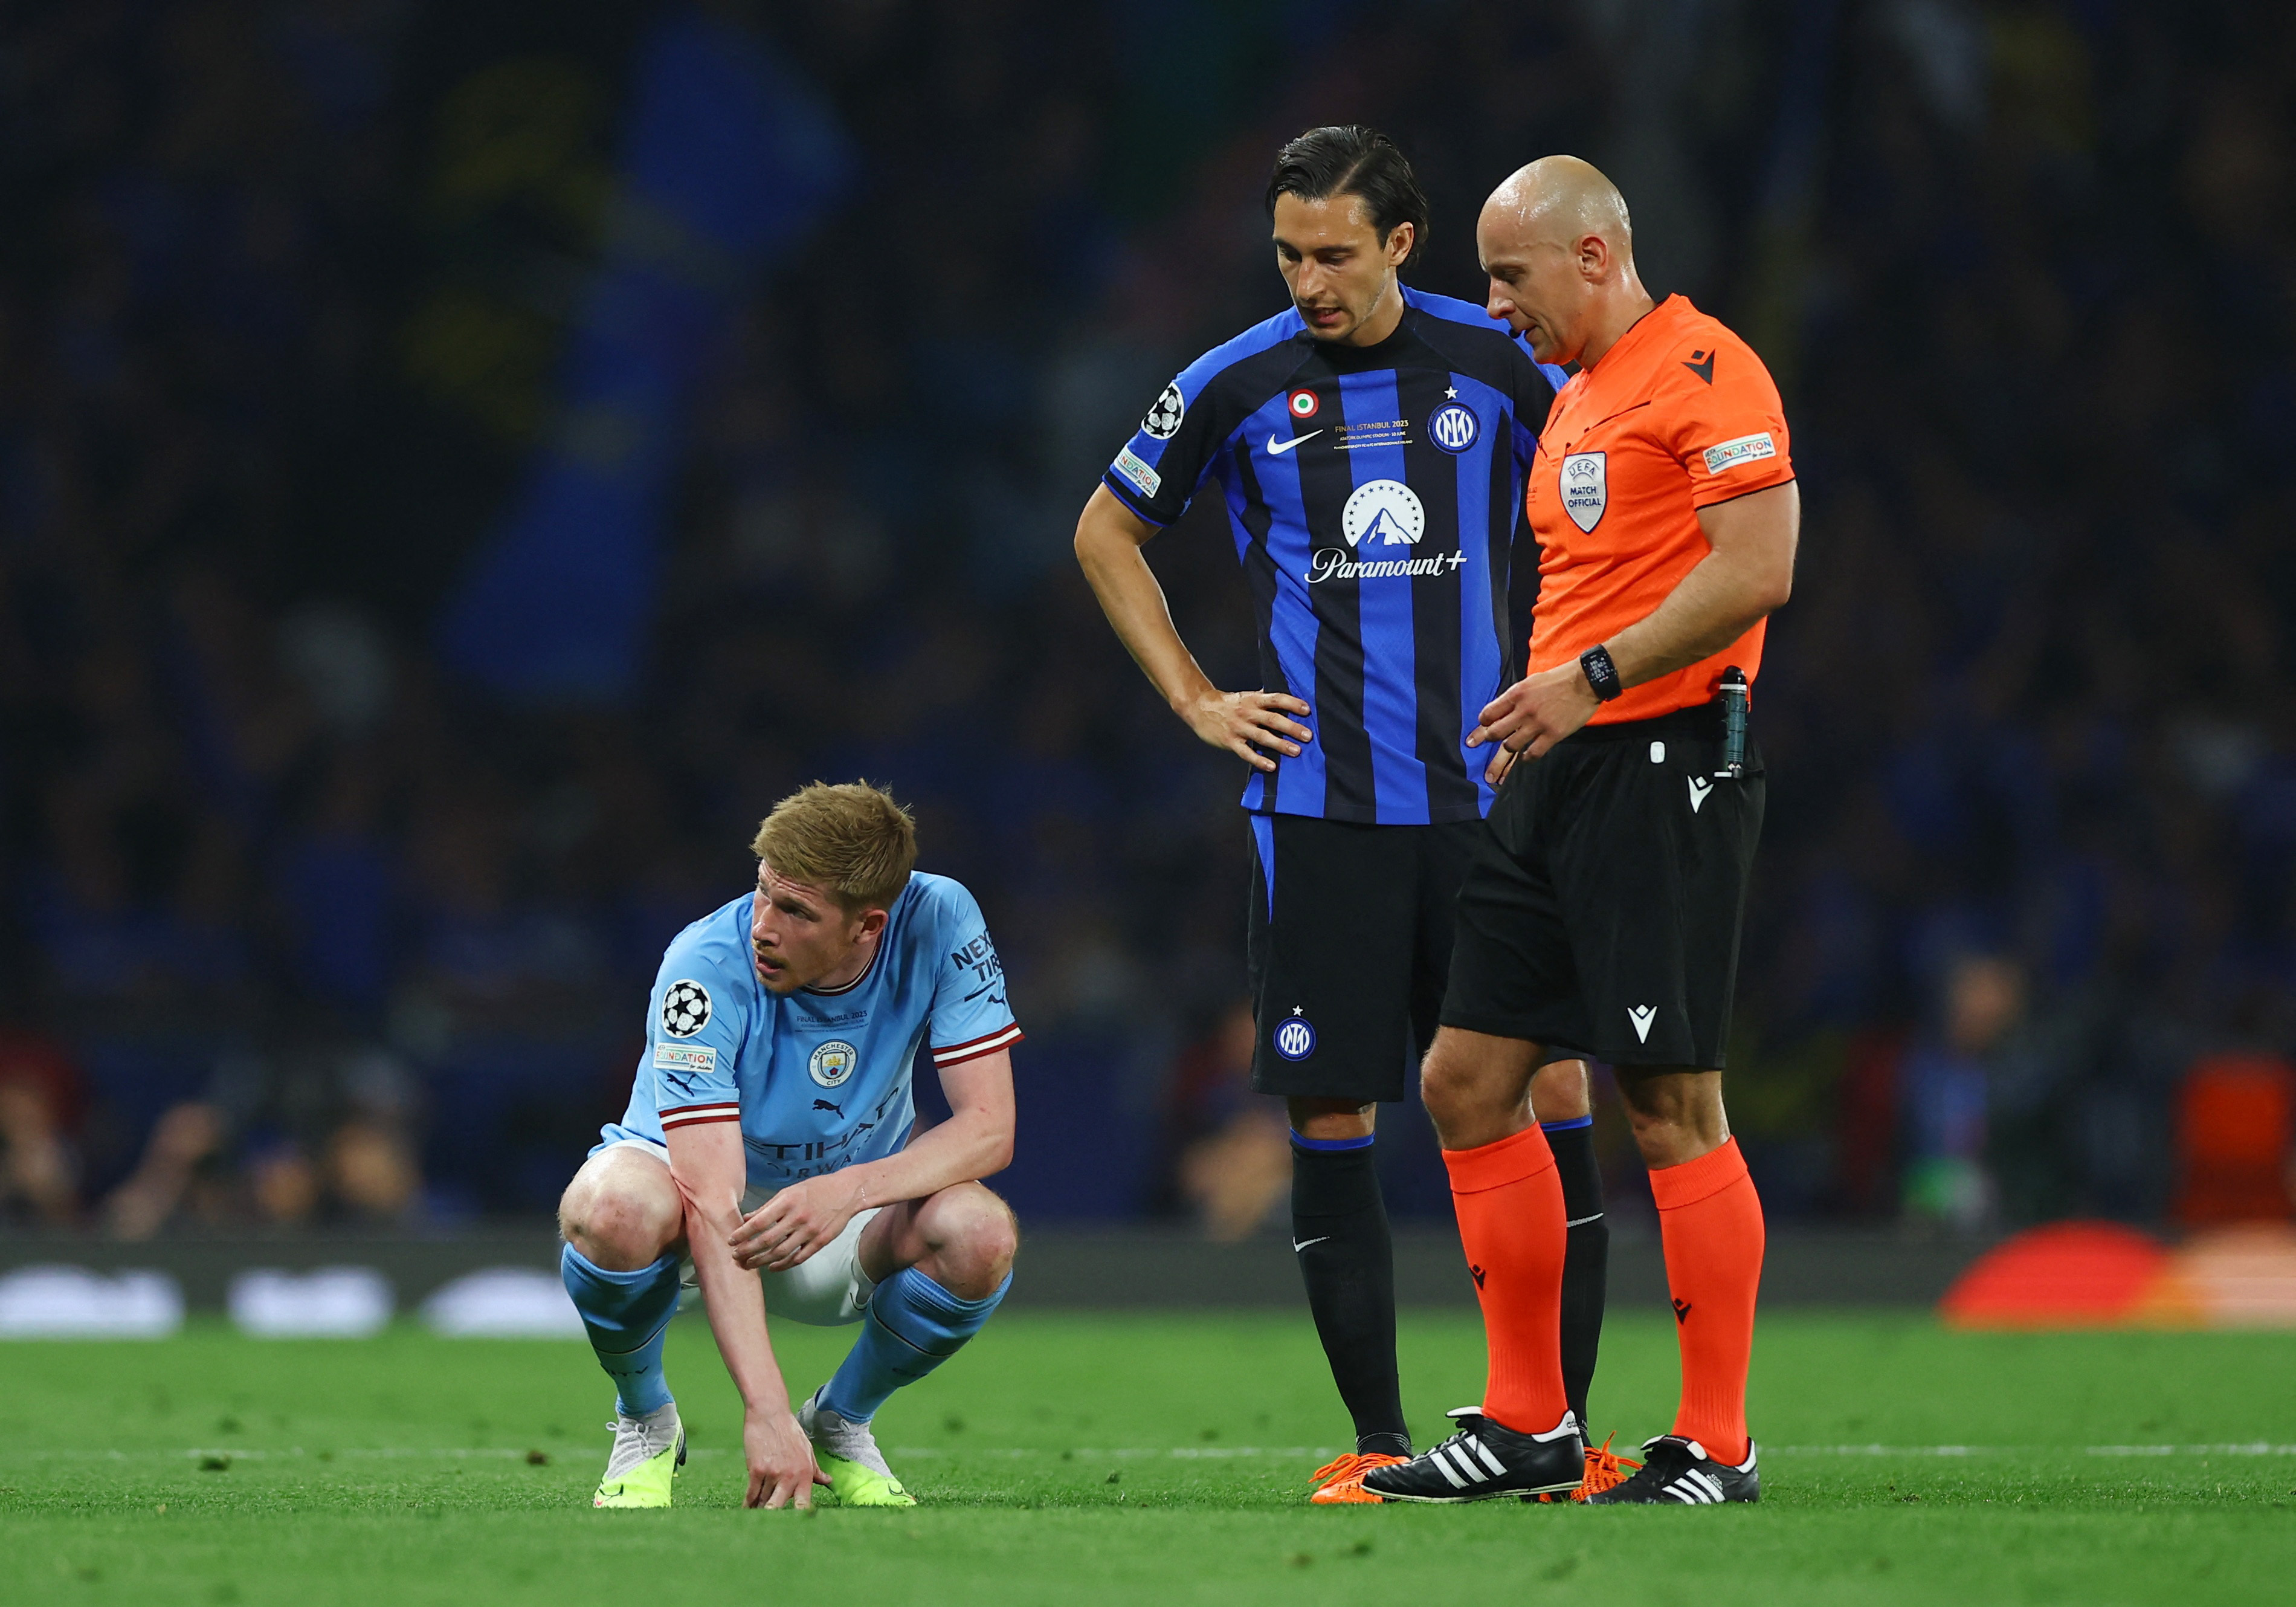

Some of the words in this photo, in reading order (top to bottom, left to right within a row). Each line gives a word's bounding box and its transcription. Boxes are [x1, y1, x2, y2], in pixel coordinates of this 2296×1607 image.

[1357, 422, 1390, 430] ISTANBUL
[1392, 419, 1409, 428] 2023
[1706, 440, 1772, 466] FOUNDATION
[1569, 462, 1595, 476] UEFA
[1570, 485, 1597, 496] MATCH
[1567, 497, 1602, 508] OFFICIAL
[1304, 548, 1468, 583] Paramount+
[950, 930, 992, 971] NEX
[972, 953, 1002, 983] TIR
[851, 1010, 868, 1019] 2023
[813, 1043, 854, 1061] MANCHESTER
